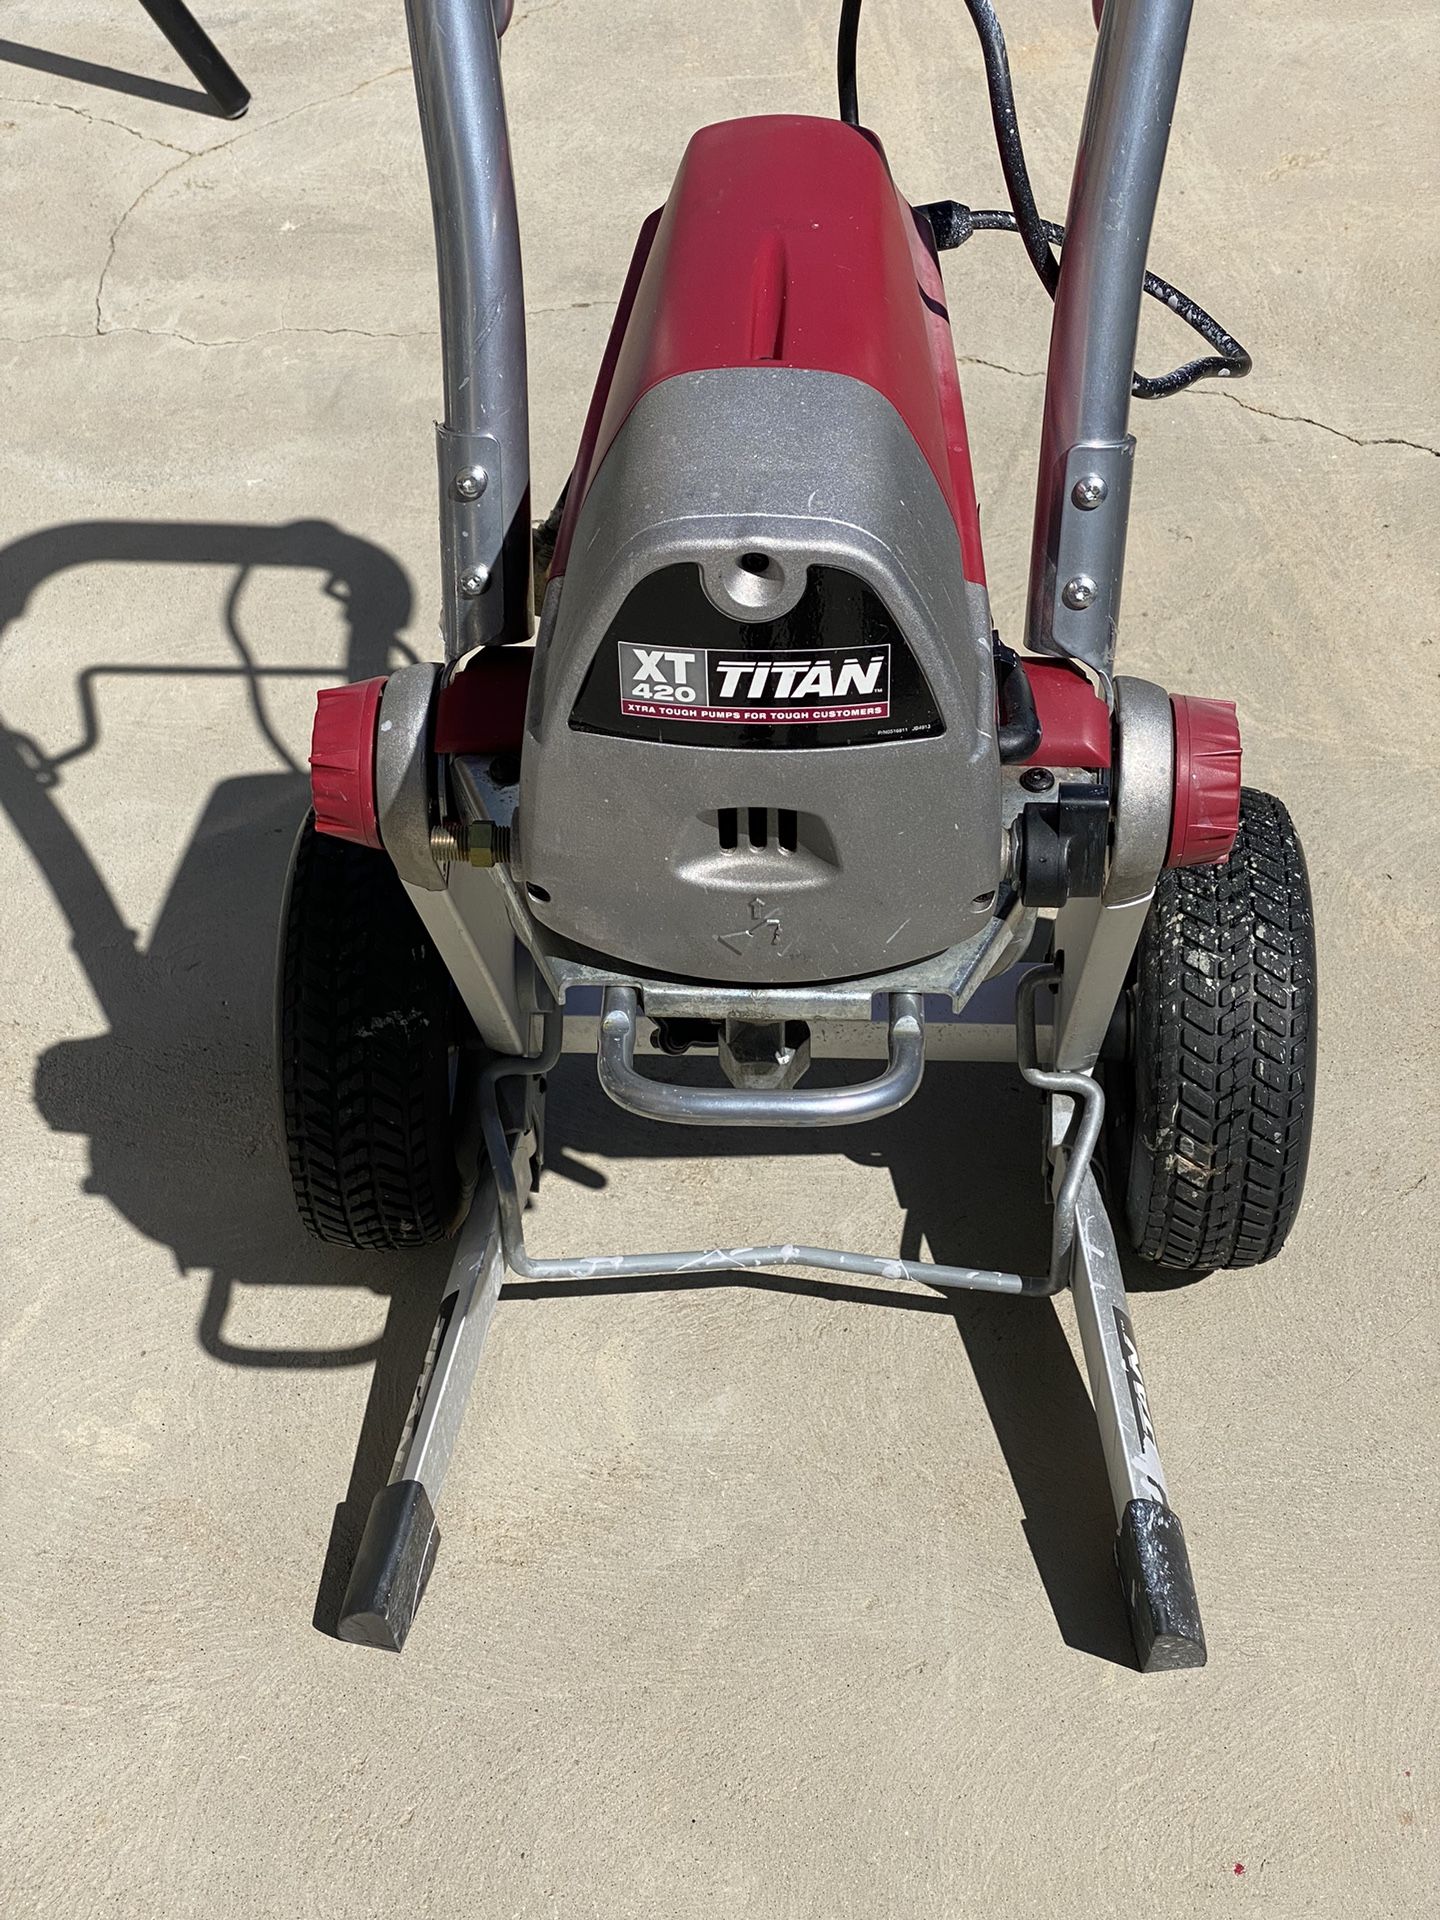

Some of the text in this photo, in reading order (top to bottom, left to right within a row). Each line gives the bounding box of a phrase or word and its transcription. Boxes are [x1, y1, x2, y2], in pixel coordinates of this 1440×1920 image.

[632, 648, 696, 685] XT
[716, 656, 885, 699] TITAN
[631, 682, 697, 703] 420
[627, 703, 882, 720] XTRA TOUGH PUMPS FOR TOUGH CUSTOMERS
